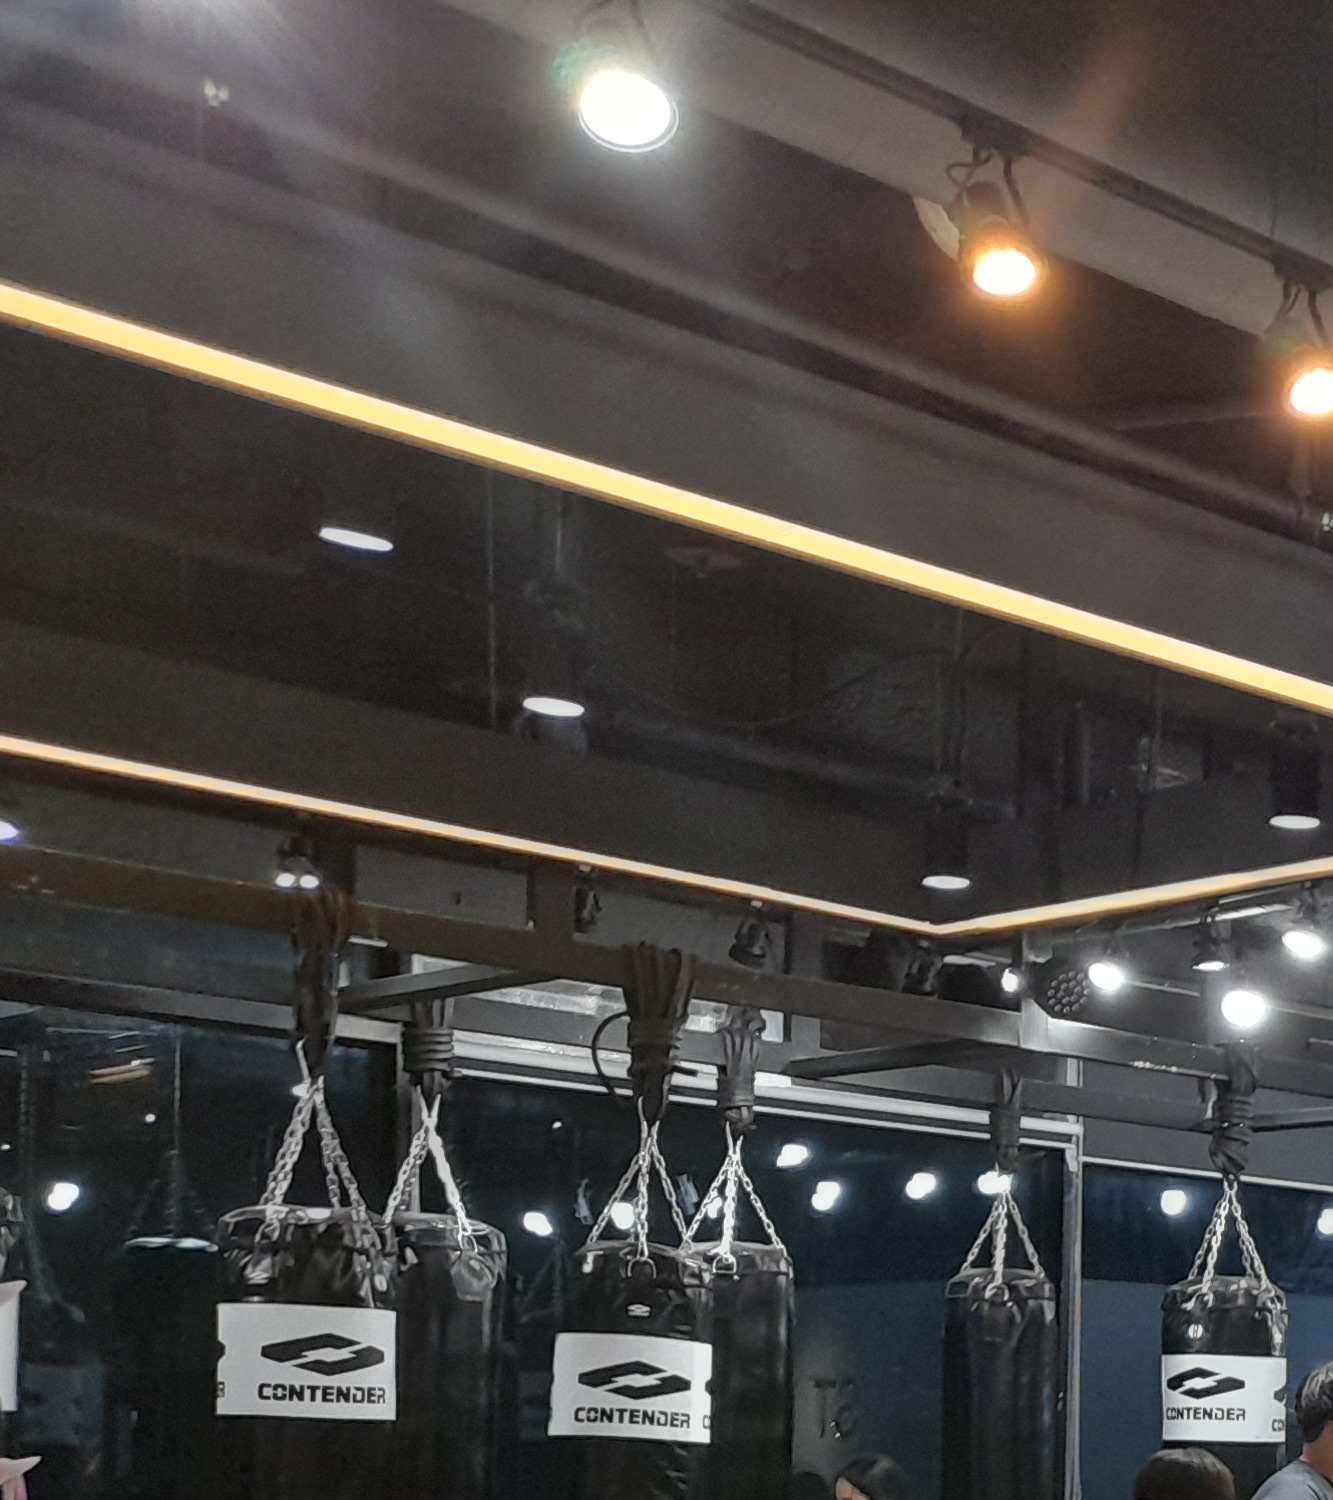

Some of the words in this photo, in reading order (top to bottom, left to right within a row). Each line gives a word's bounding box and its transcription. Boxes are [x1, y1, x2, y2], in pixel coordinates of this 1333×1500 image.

[257, 1382, 386, 1405] CONTENDER
[573, 1407, 692, 1429] CONTENDER
[1165, 1406, 1246, 1421] CONTENDER
